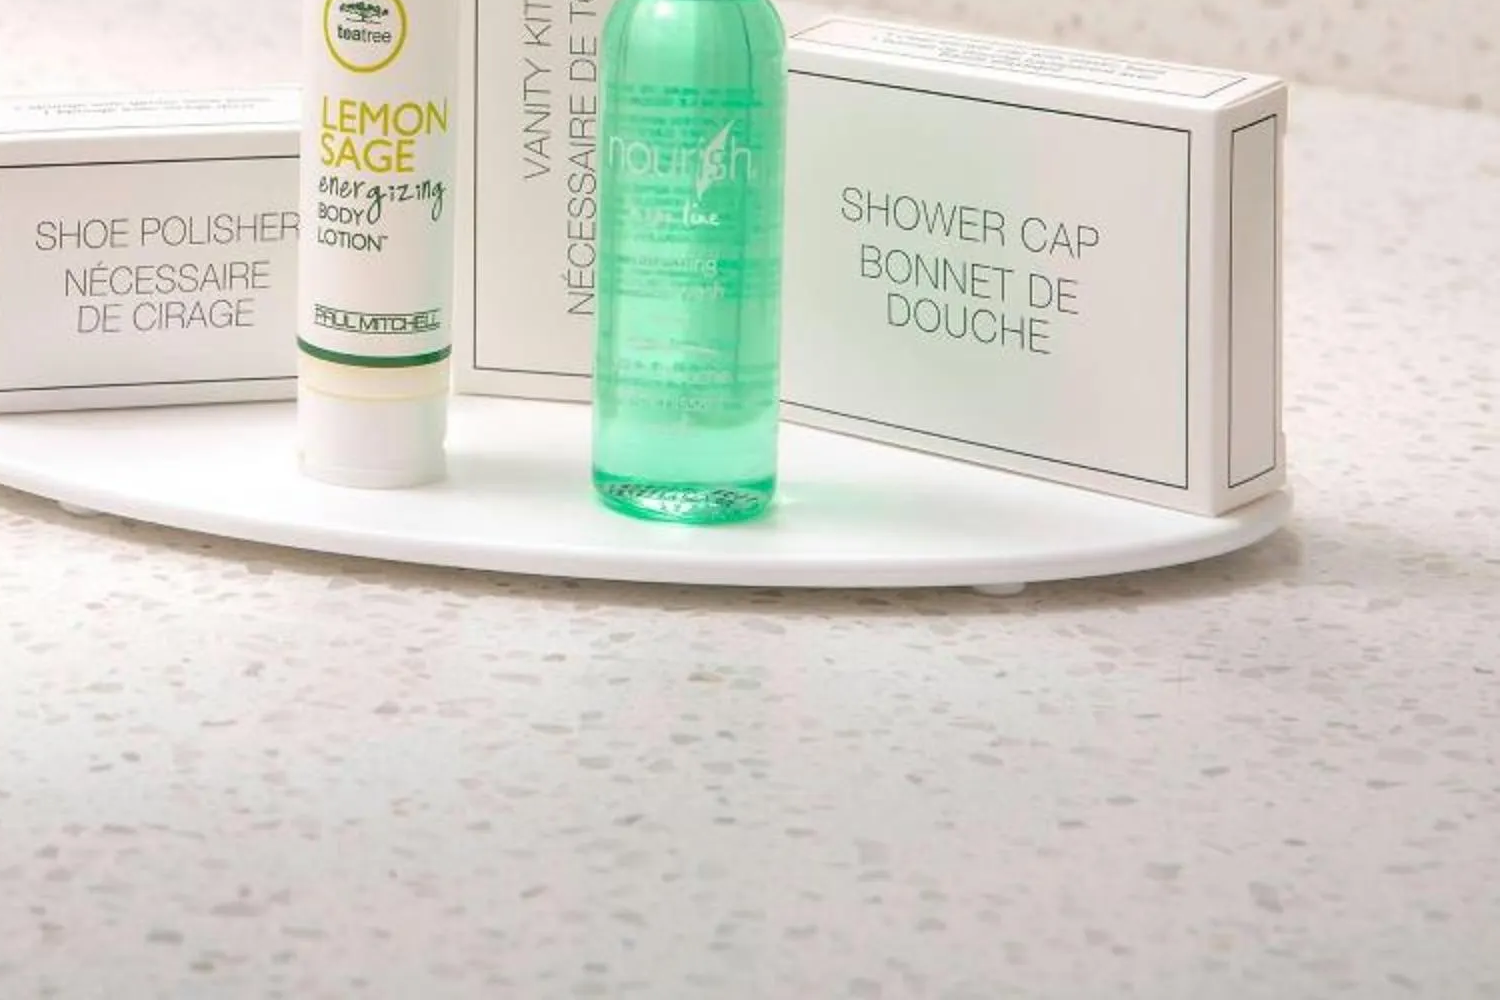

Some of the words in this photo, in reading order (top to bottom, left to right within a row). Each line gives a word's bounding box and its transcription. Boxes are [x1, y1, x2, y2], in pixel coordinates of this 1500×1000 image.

[336, 22, 392, 44] teatree
[569, 35, 597, 82] DE
[321, 96, 448, 137] LEMON
[524, 57, 552, 180] VANITY
[320, 131, 416, 173] SAGE
[317, 201, 366, 226] BODY
[318, 173, 445, 223] energizing
[560, 95, 597, 316] NÉCESSAIRE
[34, 217, 130, 252] SHOE
[140, 211, 300, 247] POLISHER
[840, 186, 1006, 247] SHOWER
[1020, 217, 1101, 260] CAP
[64, 260, 272, 298] NÉCESSAIRE
[859, 244, 1015, 302] BONNET
[1029, 273, 1080, 316] DE
[76, 304, 122, 334] DE
[132, 298, 255, 332] CIRAGE
[313, 307, 357, 331] PAUL
[357, 309, 439, 333] MITCHELL
[886, 292, 1052, 355] DOUCHE
